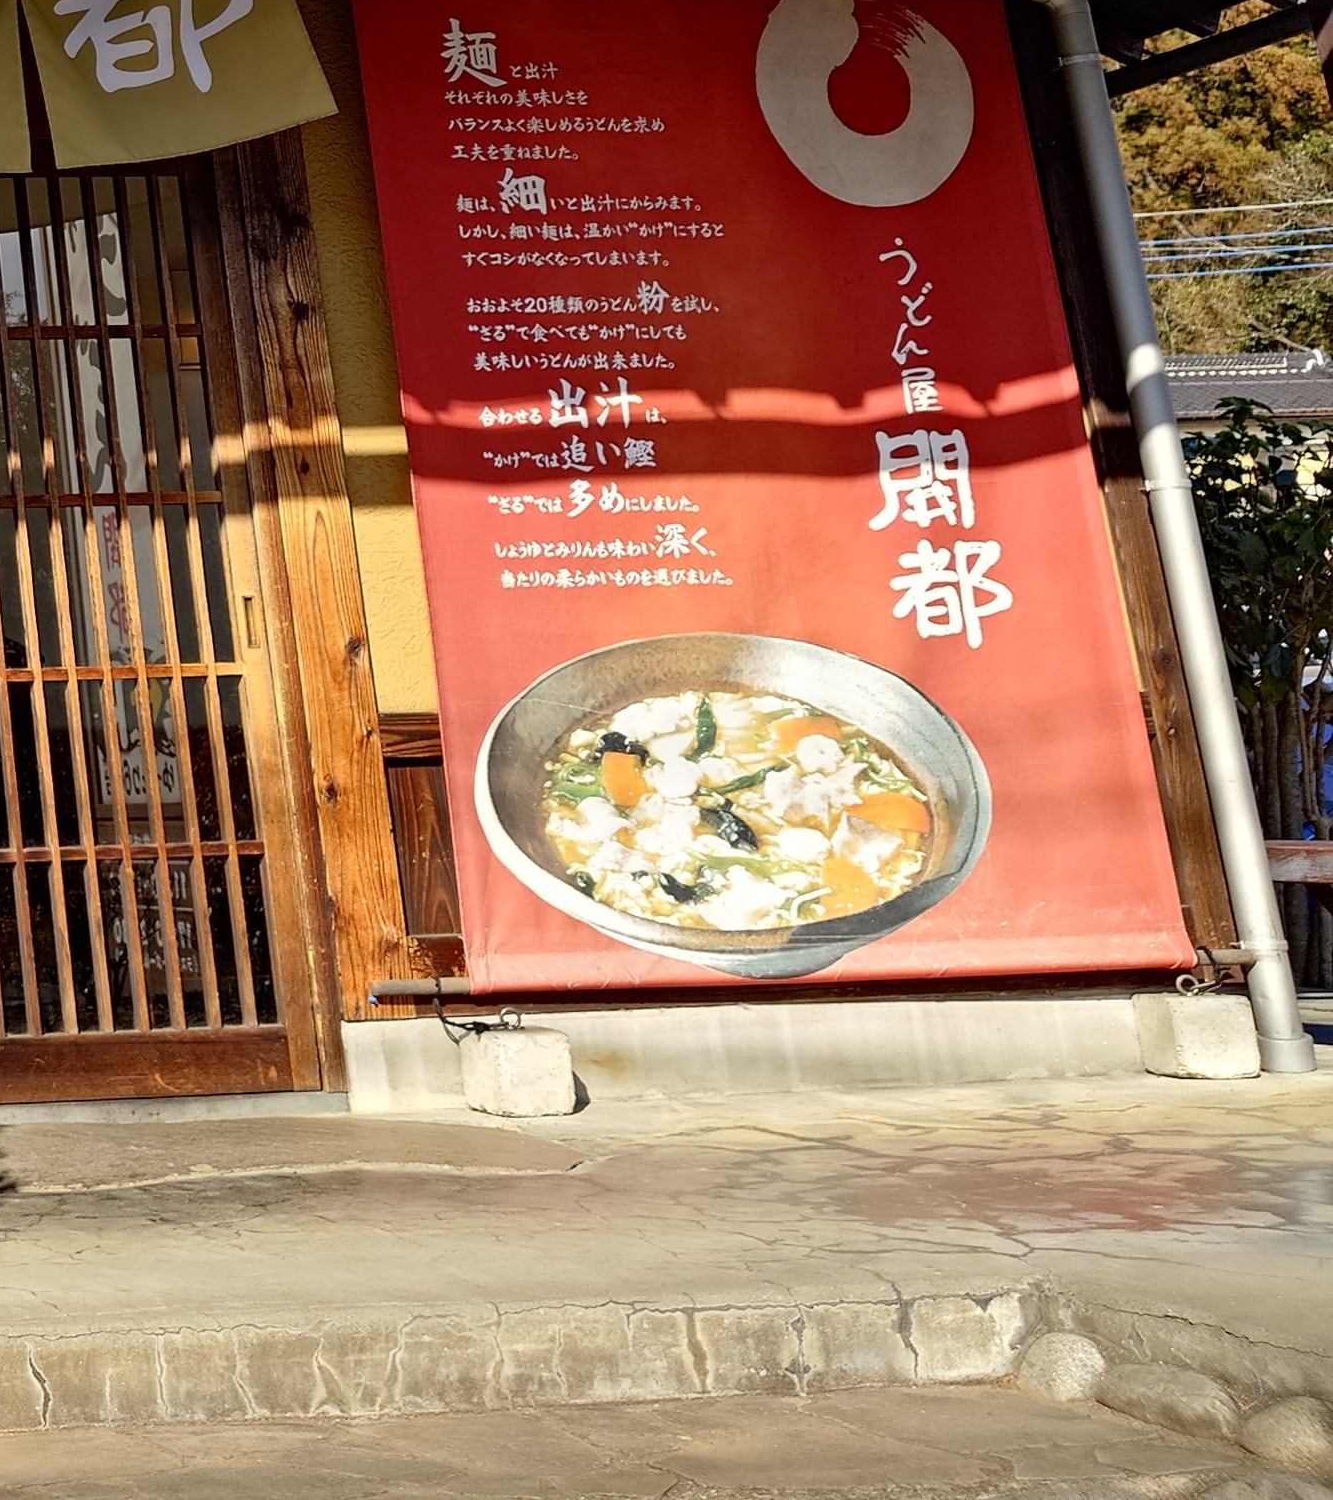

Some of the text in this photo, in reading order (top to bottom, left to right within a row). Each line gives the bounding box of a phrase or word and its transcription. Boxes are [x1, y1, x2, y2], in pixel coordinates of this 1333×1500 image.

[440, 17, 560, 88] 麺と出汁
[444, 88, 589, 108] それぞれの美味しさを
[448, 115, 666, 134] バランスよく楽しめるうどんを求め
[451, 143, 580, 161] 工夫を重ねました。
[456, 167, 703, 215] 麺は、細いと出汁にからみます。
[461, 251, 671, 268] すぐコシがなくなってしまいます。
[466, 280, 721, 315] おおよそ20種類のうどん粉を試し、
[878, 236, 945, 414] うどん屋
[473, 350, 676, 372] 美味しいうどんが出来ました。
[477, 376, 668, 429] 合わせる出汁は、
[493, 522, 718, 559] しょうゆとみりんも味わい深く、
[500, 568, 735, 589] 当たりの柔らかいものを選びました。
